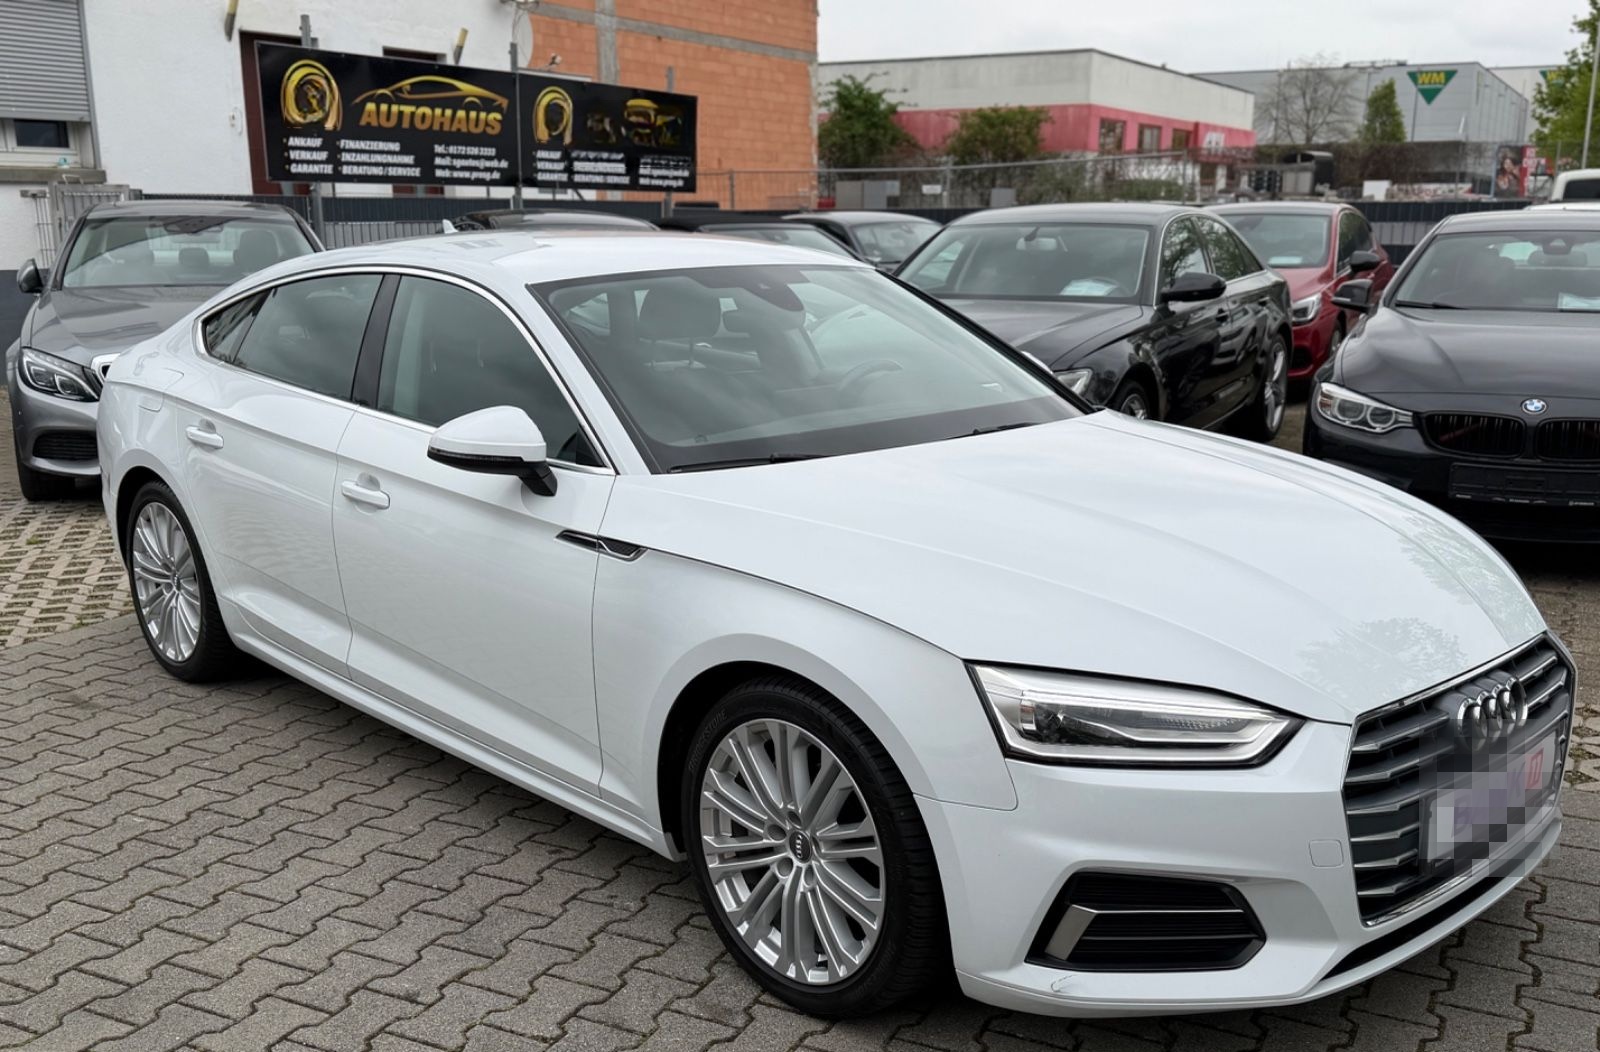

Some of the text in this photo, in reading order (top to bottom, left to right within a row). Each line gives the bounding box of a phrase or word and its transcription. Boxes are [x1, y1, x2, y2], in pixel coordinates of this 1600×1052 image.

[1417, 72, 1445, 85] WM
[360, 102, 503, 135] AUTOHAUS
[288, 136, 324, 148] ANKAUF
[340, 139, 400, 152] FINANZIERUNG
[289, 150, 329, 161] VERKAUF
[290, 163, 334, 174] GARANTIE
